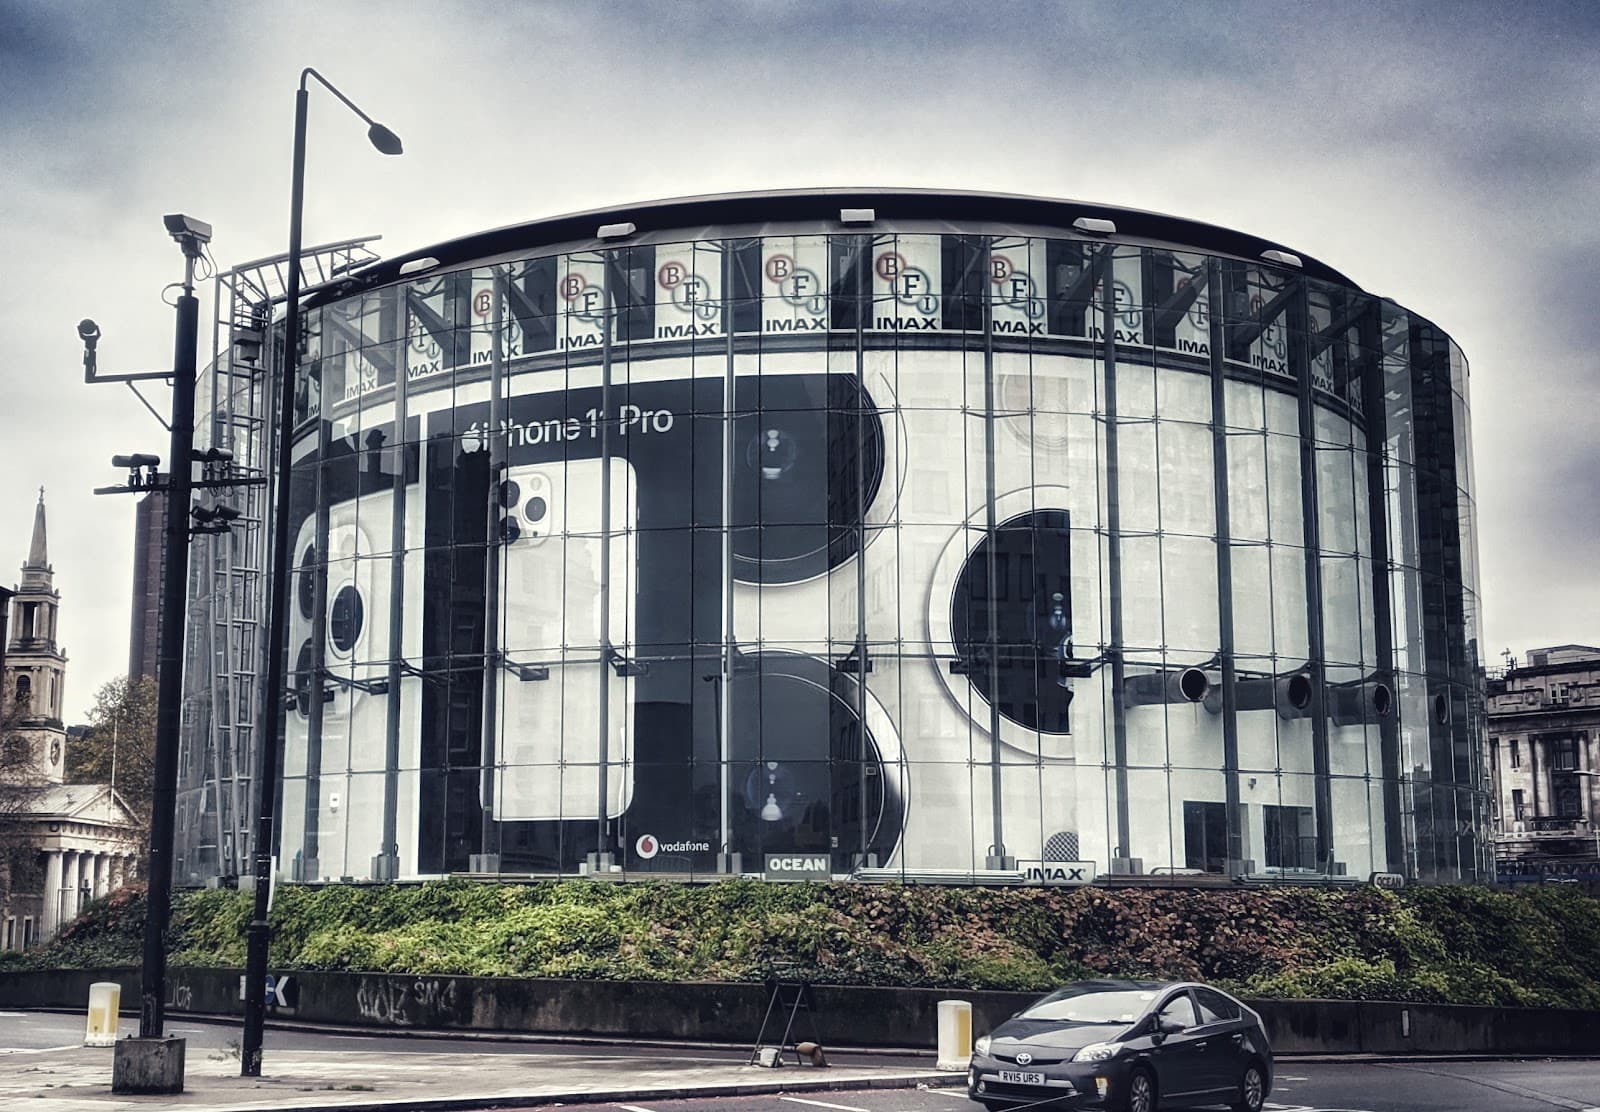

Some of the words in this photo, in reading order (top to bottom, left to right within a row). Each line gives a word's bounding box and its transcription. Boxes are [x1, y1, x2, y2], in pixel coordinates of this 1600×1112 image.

[658, 323, 717, 339] IMAX
[766, 316, 826, 332] IMAX
[877, 317, 938, 330] IMAX
[992, 320, 1044, 335] MAX
[1178, 338, 1210, 356] IMA
[407, 360, 440, 378] MAX
[1252, 354, 1287, 375] IMAX
[346, 379, 377, 399] IMAX
[1311, 374, 1334, 393] MAX
[483, 417, 581, 451] ihone
[585, 407, 605, 439] 1
[619, 404, 674, 436] Pro
[660, 841, 710, 852] vodafone
[769, 858, 826, 871] OCEAN
[1027, 867, 1083, 881] IMAX
[1003, 1072, 1021, 1082] RV15
[1023, 1074, 1039, 1083] URS
